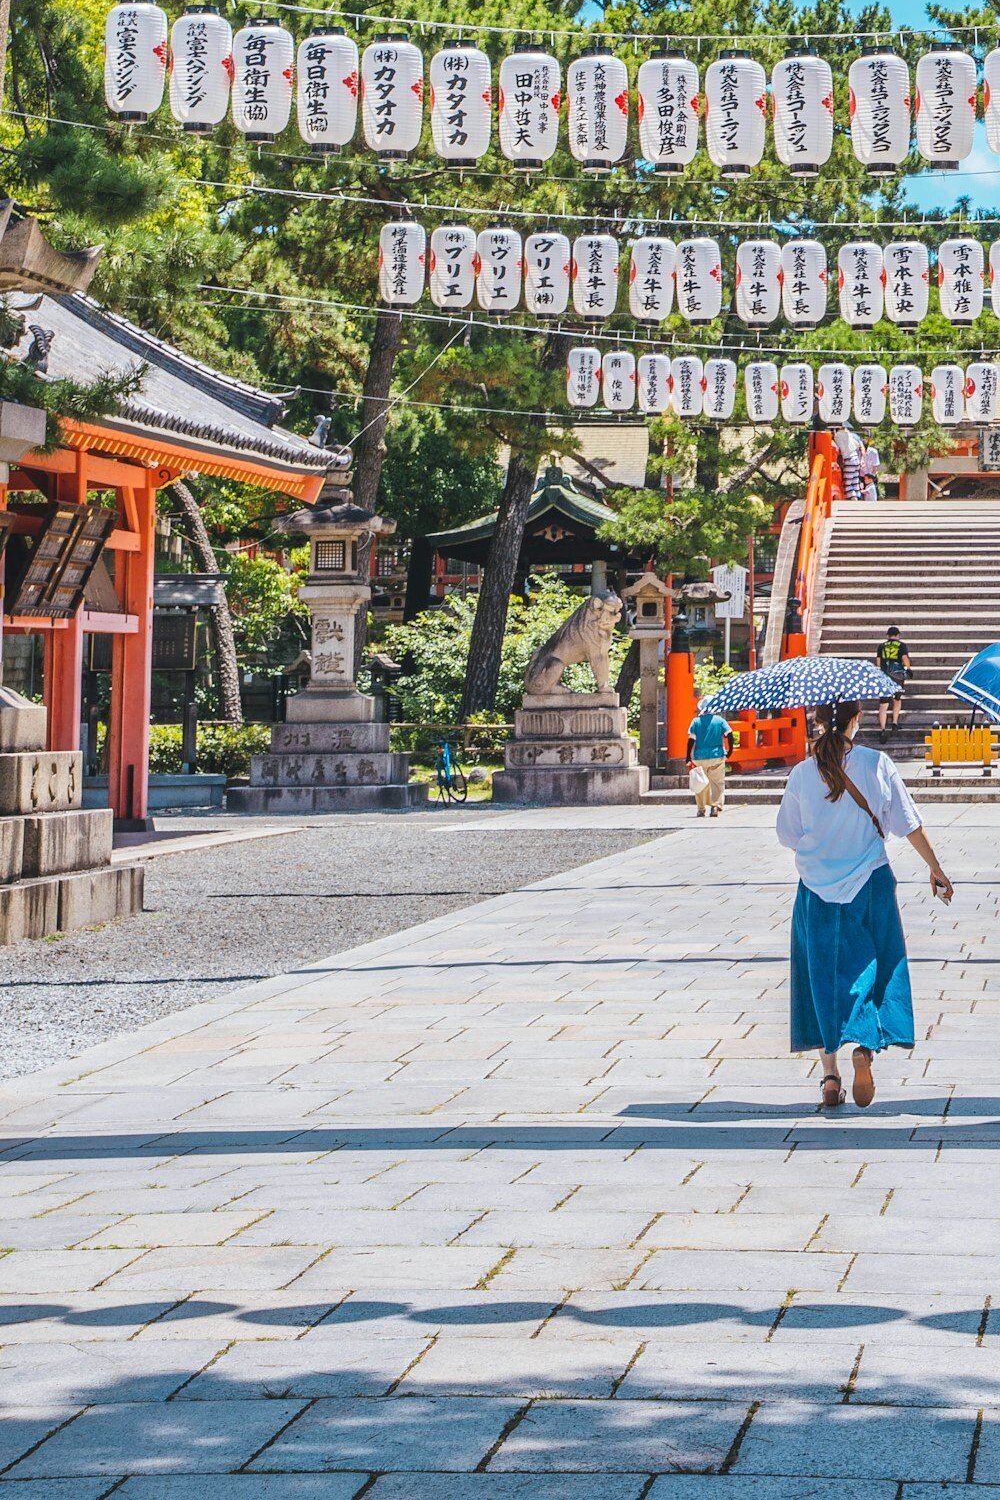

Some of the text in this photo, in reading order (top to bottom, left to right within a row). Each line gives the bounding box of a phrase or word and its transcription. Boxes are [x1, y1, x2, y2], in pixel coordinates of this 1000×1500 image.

[242, 34, 274, 121] 毎日衛生(協)
[304, 43, 332, 133] 毎日衛生(協)
[373, 50, 398, 136] (株)カタオカ
[443, 55, 469, 146] (株)カタオカ
[513, 73, 534, 147] 田中哲夫
[656, 87, 675, 156] 多田俊彦
[586, 240, 606, 308] 株式会社牛長
[641, 243, 662, 311] 株式会社牛長
[682, 245, 701, 312] 株式会社牛長
[748, 246, 768, 316] 株式会社牛長
[792, 246, 811, 315] 株式会社牛長
[852, 248, 872, 317] 株式会社牛長
[892, 246, 914, 313] 雪本佳央
[952, 244, 973, 313] 雪本雅彦
